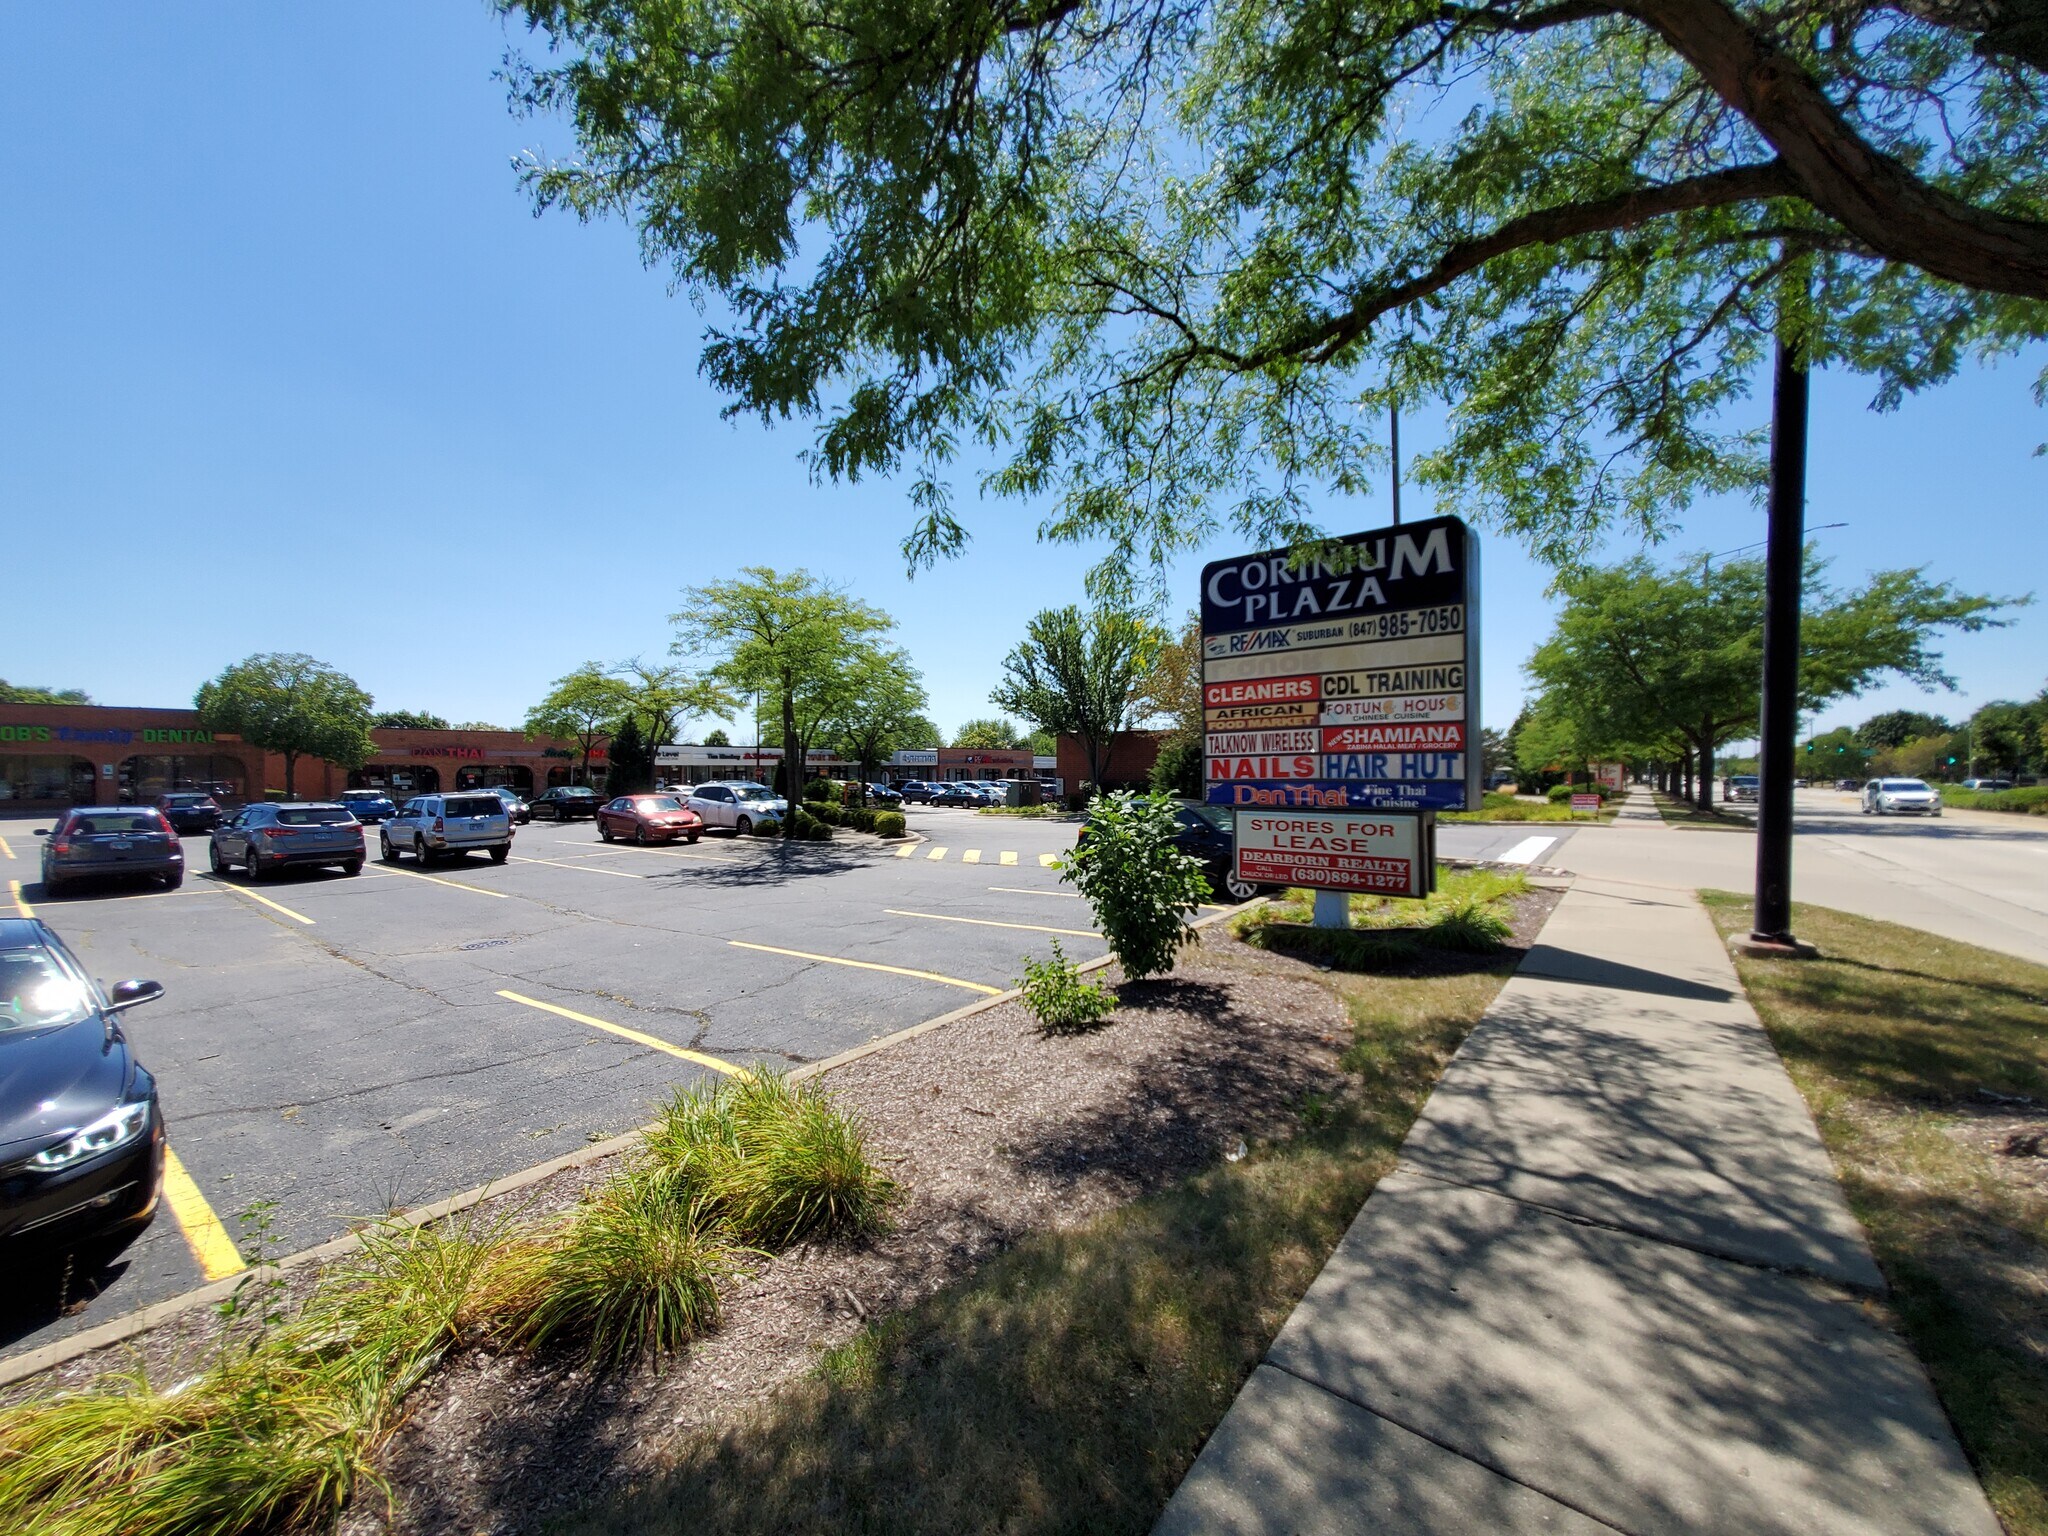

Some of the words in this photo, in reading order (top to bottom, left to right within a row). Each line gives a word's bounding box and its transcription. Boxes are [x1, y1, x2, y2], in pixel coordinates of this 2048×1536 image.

[1245, 576, 1387, 623] PLAZA
[1230, 629, 1291, 653] RE/MAX
[1297, 626, 1344, 642] SUBURBAN
[1349, 620, 1377, 638] (847)
[1379, 606, 1461, 638] 985-7050
[1324, 675, 1360, 696] CDL
[1366, 666, 1463, 693] TRAINING
[1208, 680, 1313, 704] CLEANERS
[1216, 705, 1303, 719] AFRICAN
[1353, 714, 1389, 722] CHINESE
[1394, 711, 1431, 720] CUISINE
[1207, 720, 1246, 730] FOOD
[1248, 716, 1315, 728] MARKET
[144, 730, 216, 743] DENTAL
[1208, 734, 1257, 754] TALKNOW
[1261, 732, 1314, 752] WIRELESS
[1327, 733, 1344, 747] NEW
[1342, 726, 1461, 744] SHAMIANA
[411, 748, 444, 757] DAN
[446, 748, 486, 759] THAI
[1211, 756, 1315, 779] NAILS
[1327, 753, 1388, 779] HAIR
[1401, 753, 1458, 778] HUT
[1365, 784, 1393, 796] Fine
[1396, 784, 1427, 796] Thai
[1371, 795, 1420, 808] Cuisine
[1251, 819, 1334, 834] STORES
[1347, 823, 1394, 837] FOR
[1273, 835, 1369, 853] LEASE
[1242, 851, 1330, 867] DEARBORN
[1337, 857, 1408, 873] REALTY
[1256, 865, 1273, 873] CALL
[1241, 870, 1264, 878] CHUCK
[1291, 868, 1407, 889] (630)894-1277
